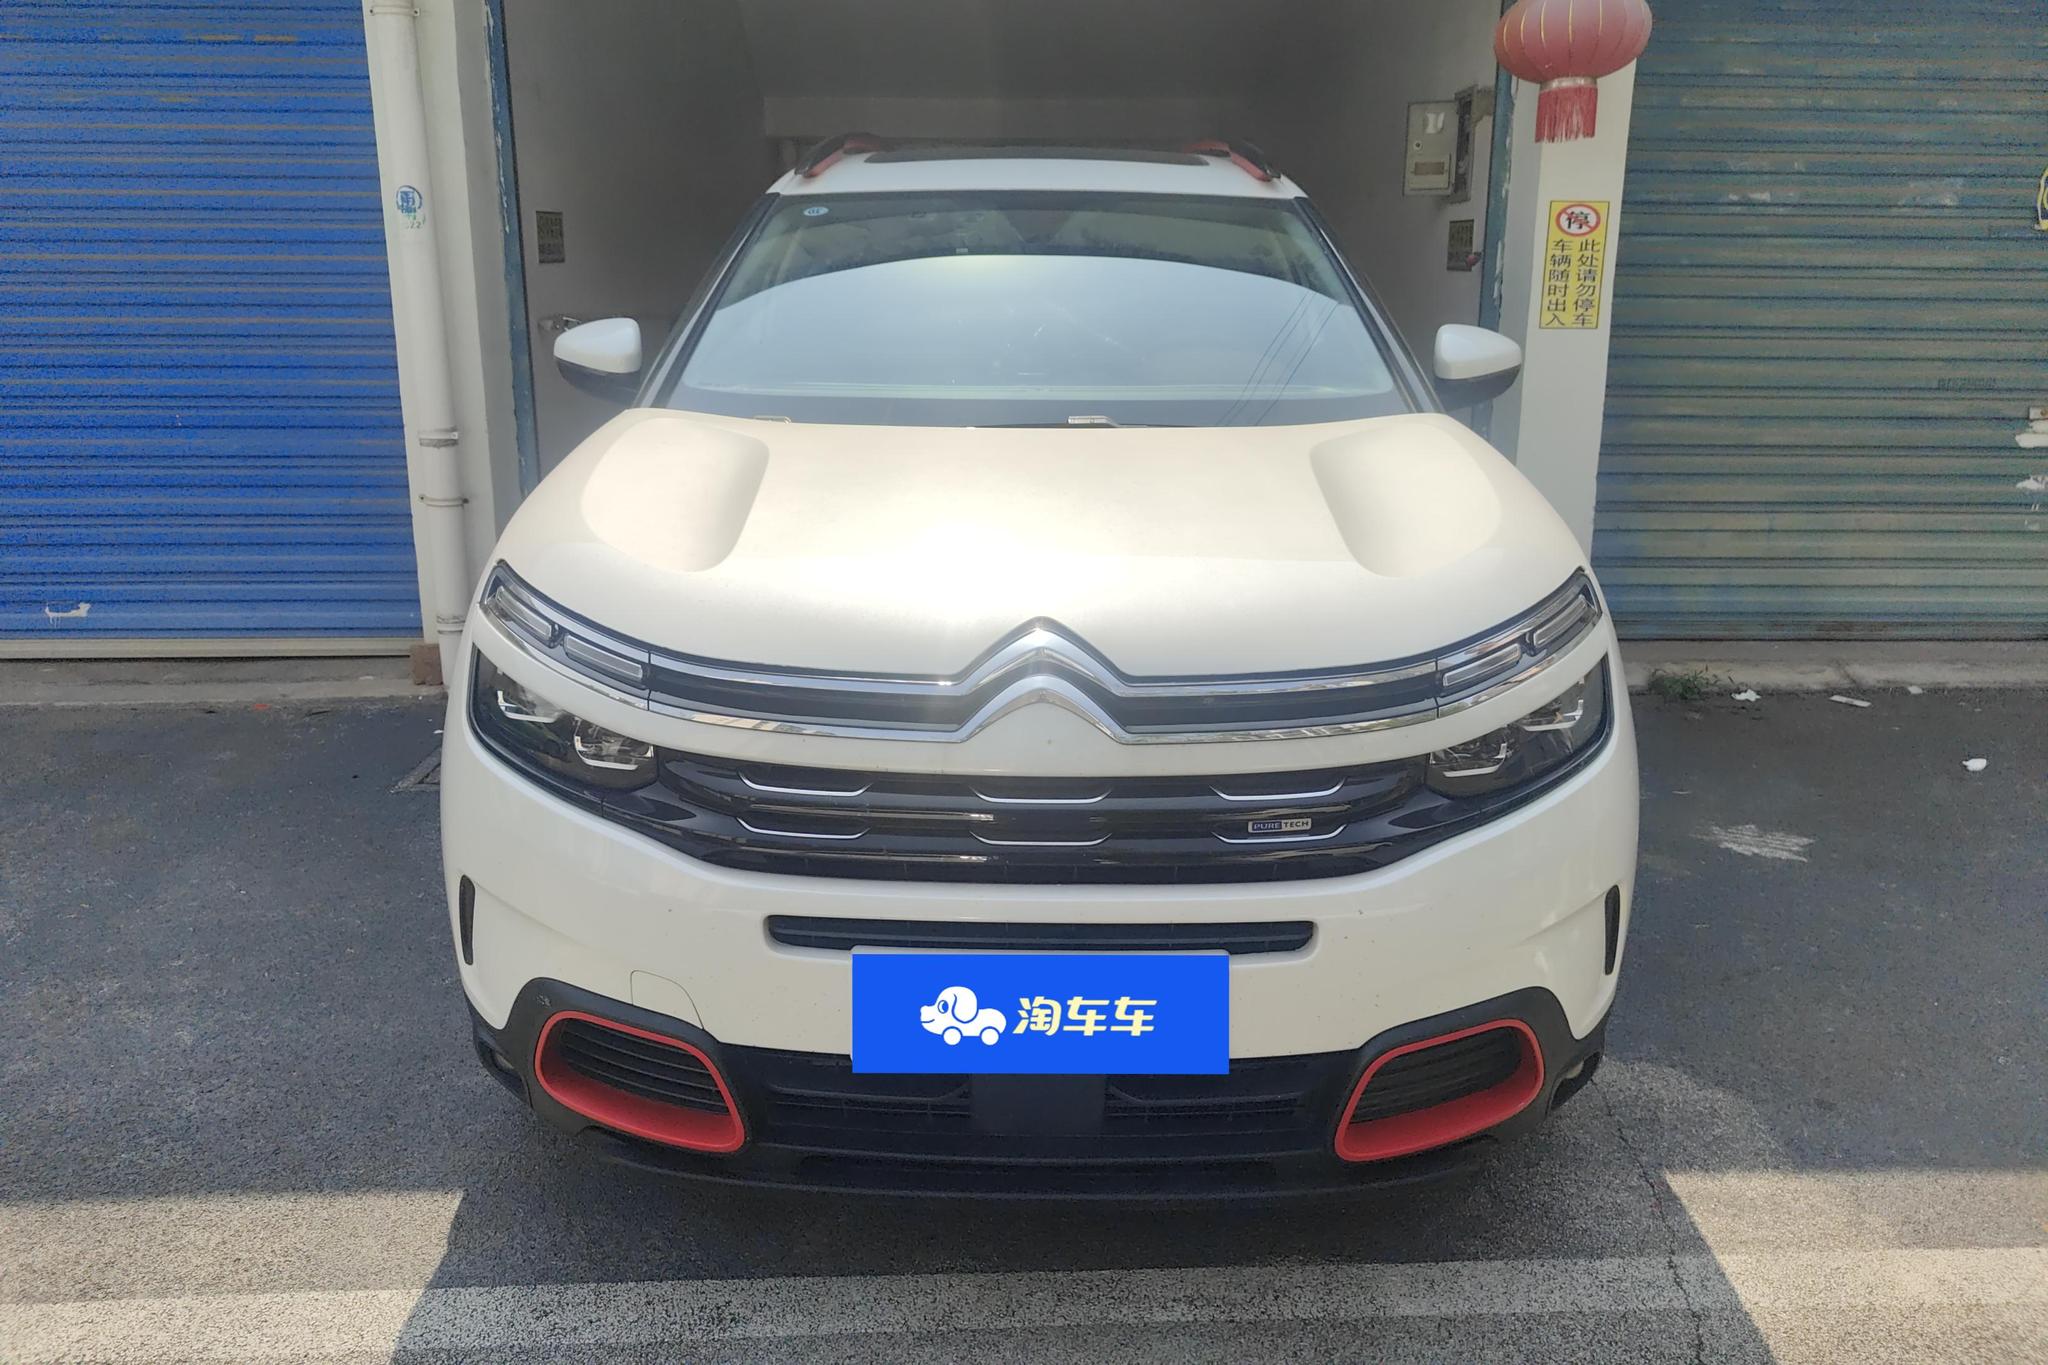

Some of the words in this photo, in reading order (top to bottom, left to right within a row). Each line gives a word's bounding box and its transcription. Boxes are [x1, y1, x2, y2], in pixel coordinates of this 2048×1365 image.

[1565, 210, 1591, 230] 停
[1545, 239, 1573, 327] 车辆随时出入
[1572, 239, 1601, 327] 此处请勿停车
